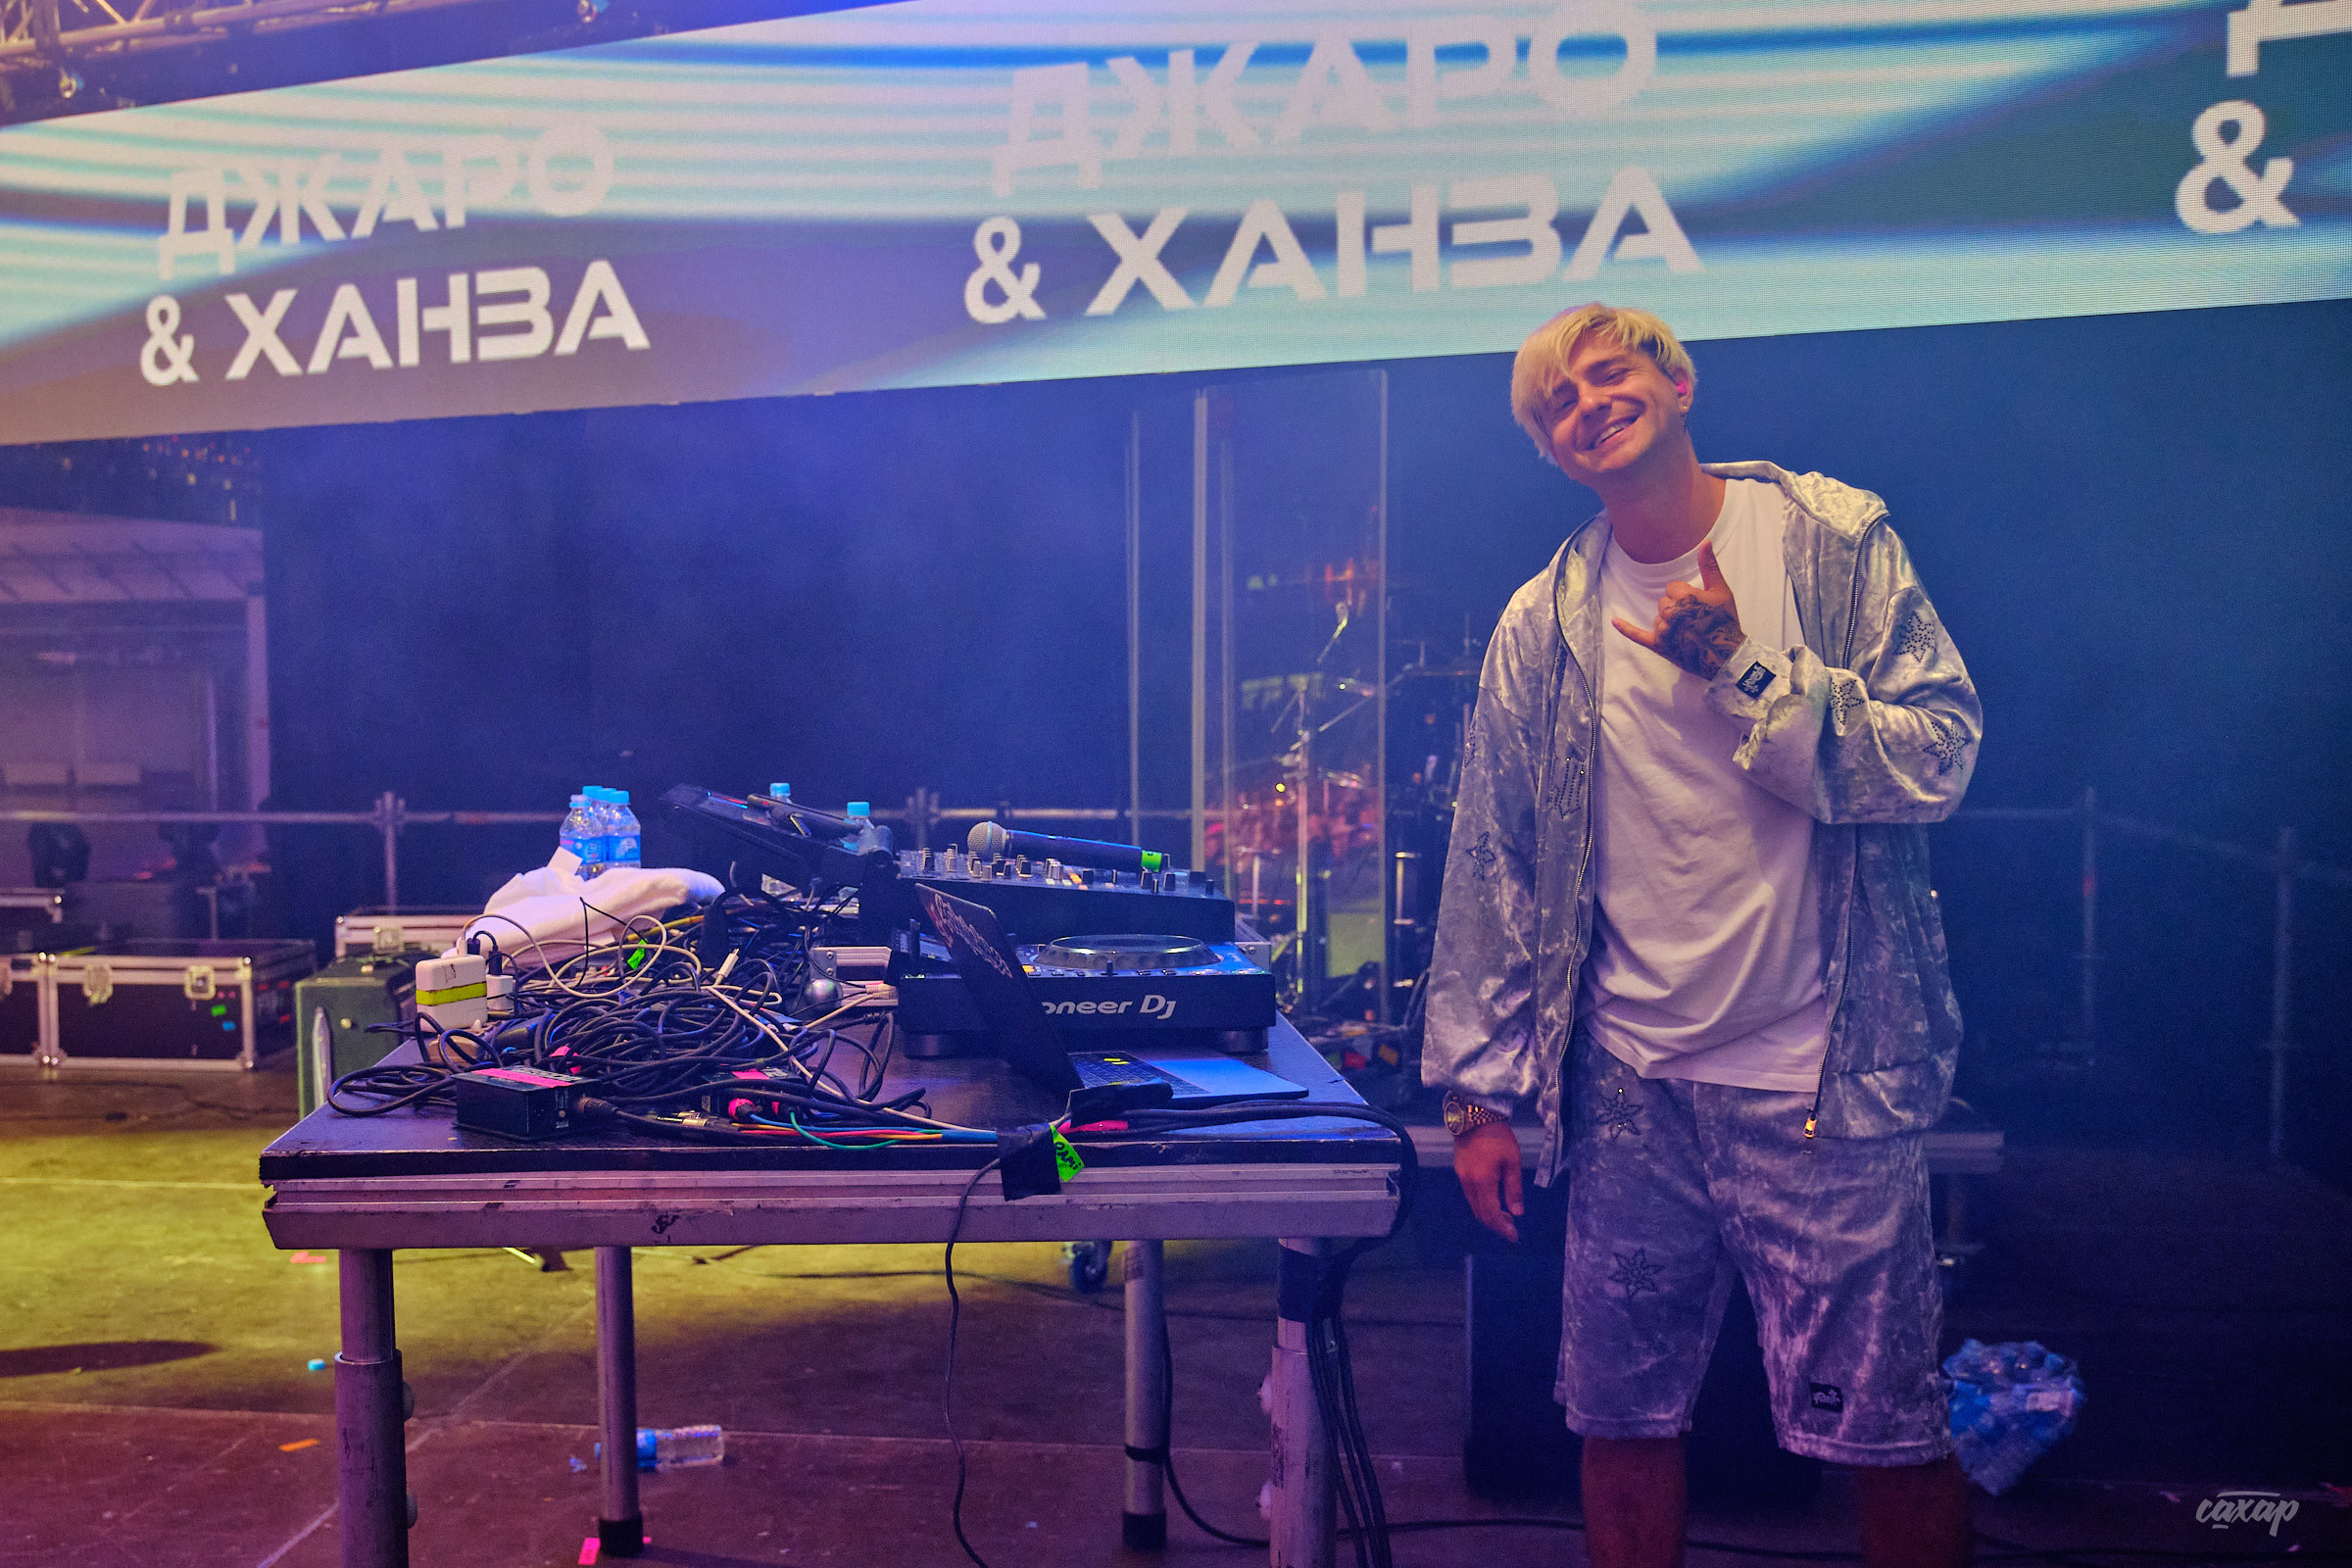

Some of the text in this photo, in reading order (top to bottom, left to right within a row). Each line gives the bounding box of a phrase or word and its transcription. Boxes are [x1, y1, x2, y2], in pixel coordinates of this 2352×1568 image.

[993, 1, 1657, 197] ДЖАРО
[2175, 100, 2301, 233] &
[159, 121, 614, 280] ДЖАРО
[964, 166, 1706, 324] & ХАНЗА
[140, 260, 651, 386] & ХАНЗА
[1041, 1001, 1133, 1014] oneer
